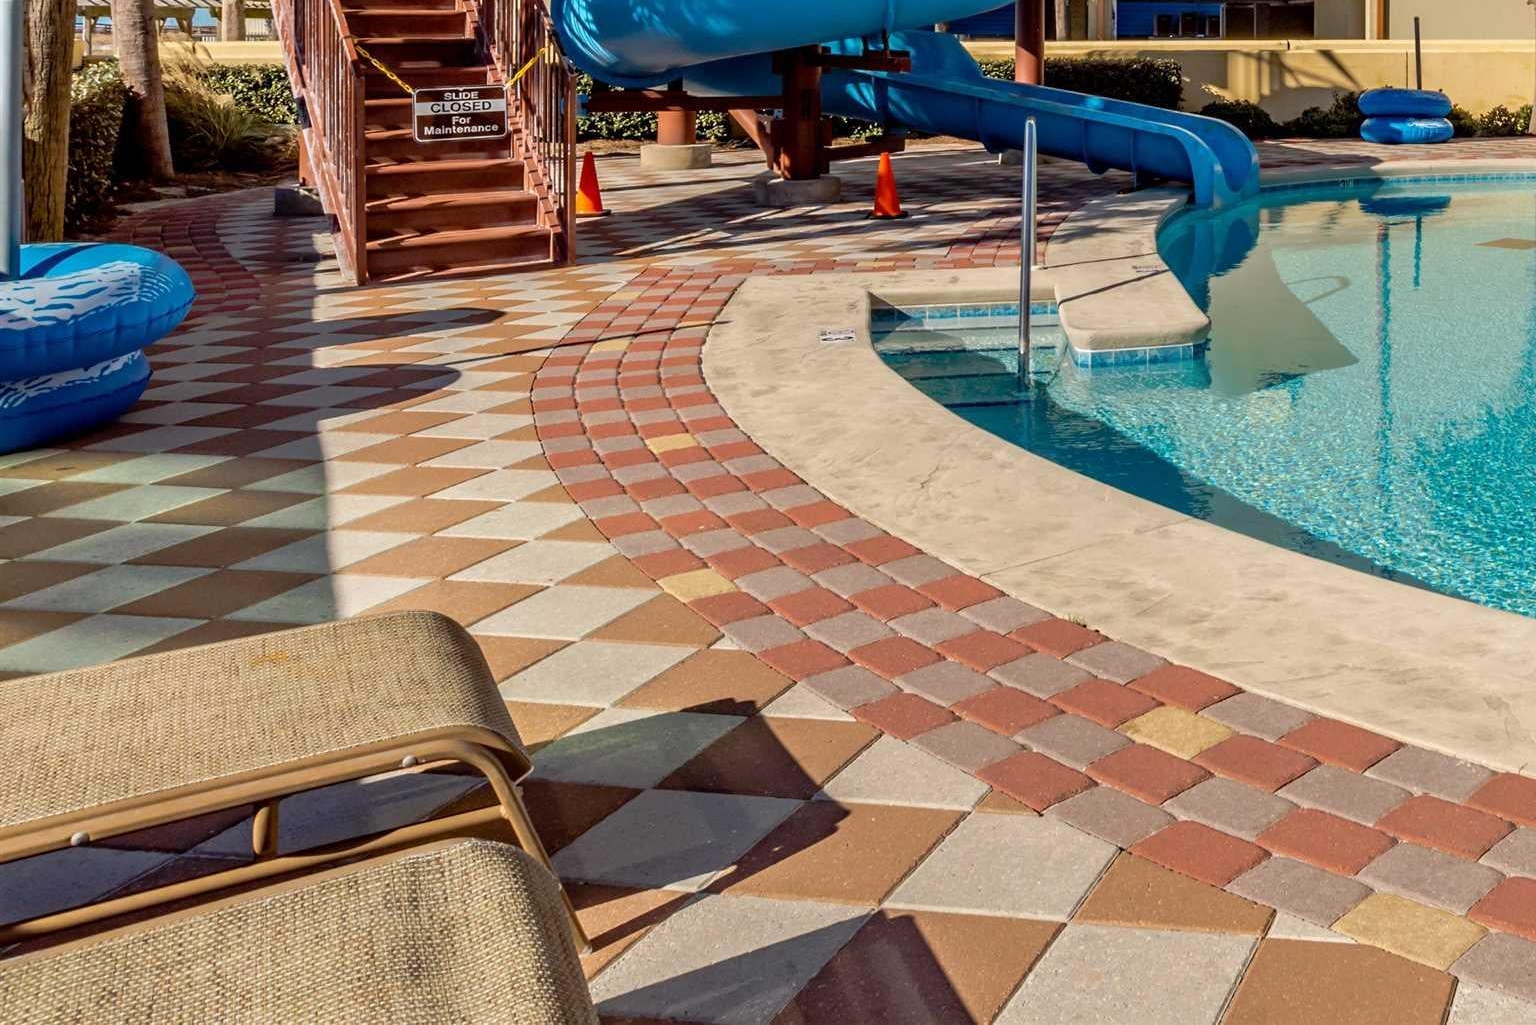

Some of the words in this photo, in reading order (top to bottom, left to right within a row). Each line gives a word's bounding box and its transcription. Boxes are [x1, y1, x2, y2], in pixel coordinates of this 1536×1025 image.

[443, 91, 479, 100] SLIDE
[430, 101, 492, 113] CLOSED
[451, 116, 472, 125] For
[424, 124, 499, 135] Maintenance
